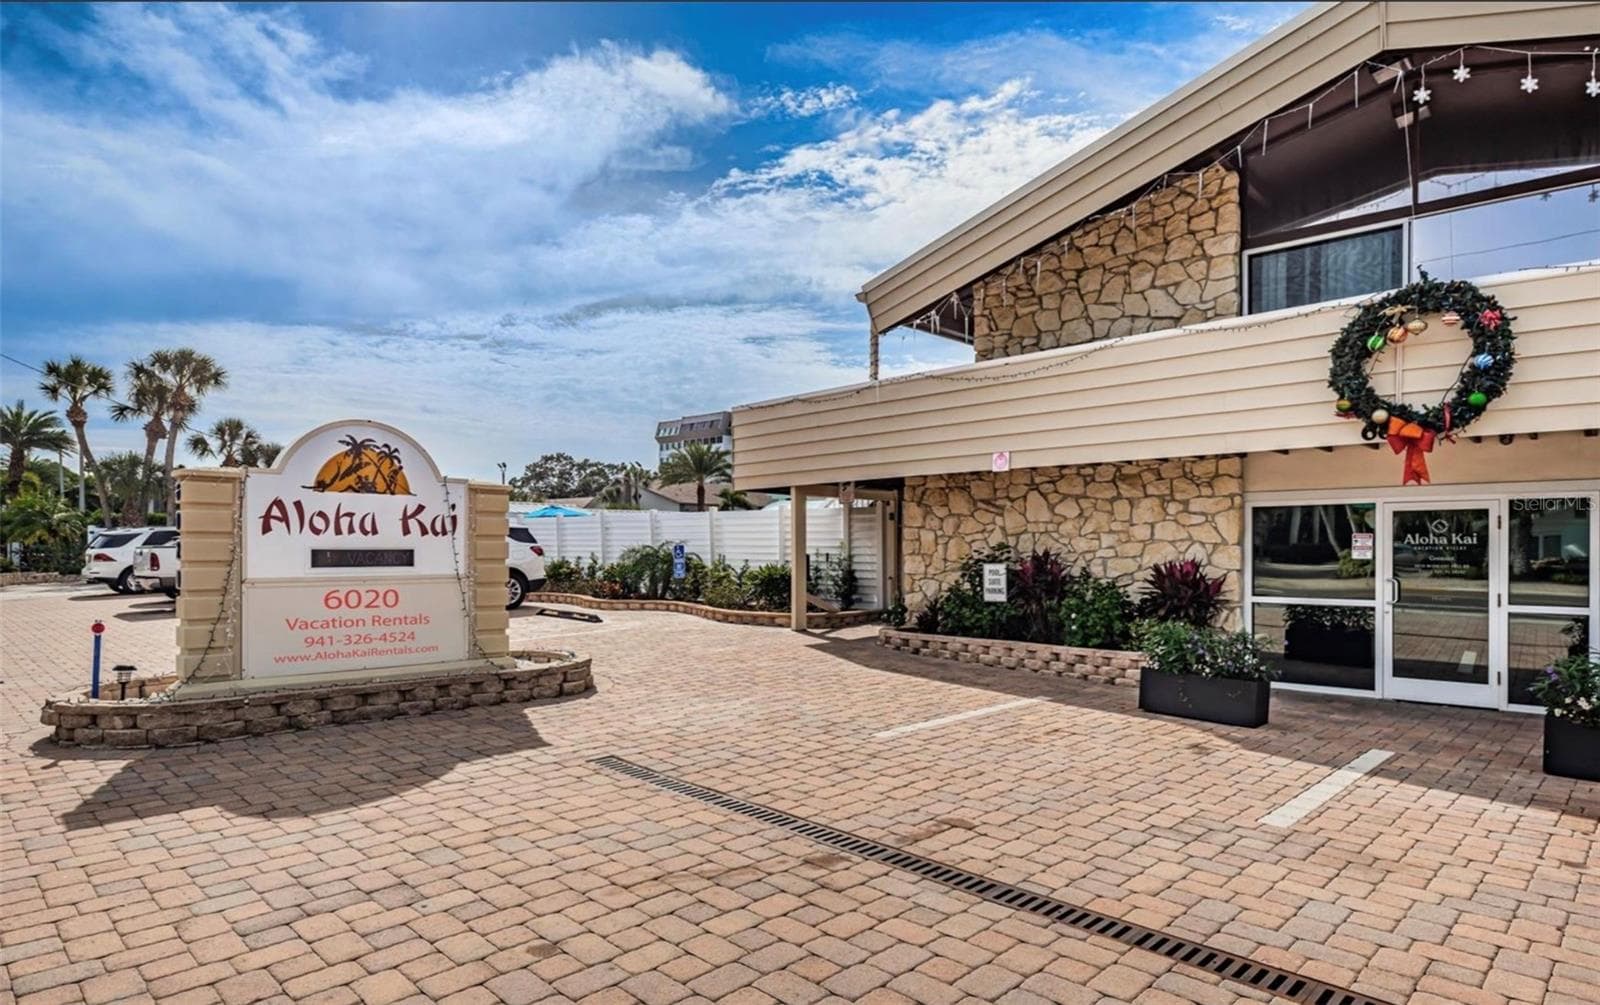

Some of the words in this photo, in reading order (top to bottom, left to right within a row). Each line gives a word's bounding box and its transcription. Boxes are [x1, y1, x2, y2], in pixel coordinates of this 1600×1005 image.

[259, 496, 379, 537] Aloha
[400, 503, 458, 537] Kai
[1403, 532, 1448, 545] Aloha
[1451, 532, 1478, 545] Kai
[346, 551, 410, 565] VACANCY
[323, 588, 400, 610] 6020
[285, 616, 366, 631] Vacation
[371, 613, 430, 628] Rentals
[304, 631, 416, 648] 941-326-4524
[273, 643, 439, 665] www.AlohaKaiRentals.com
